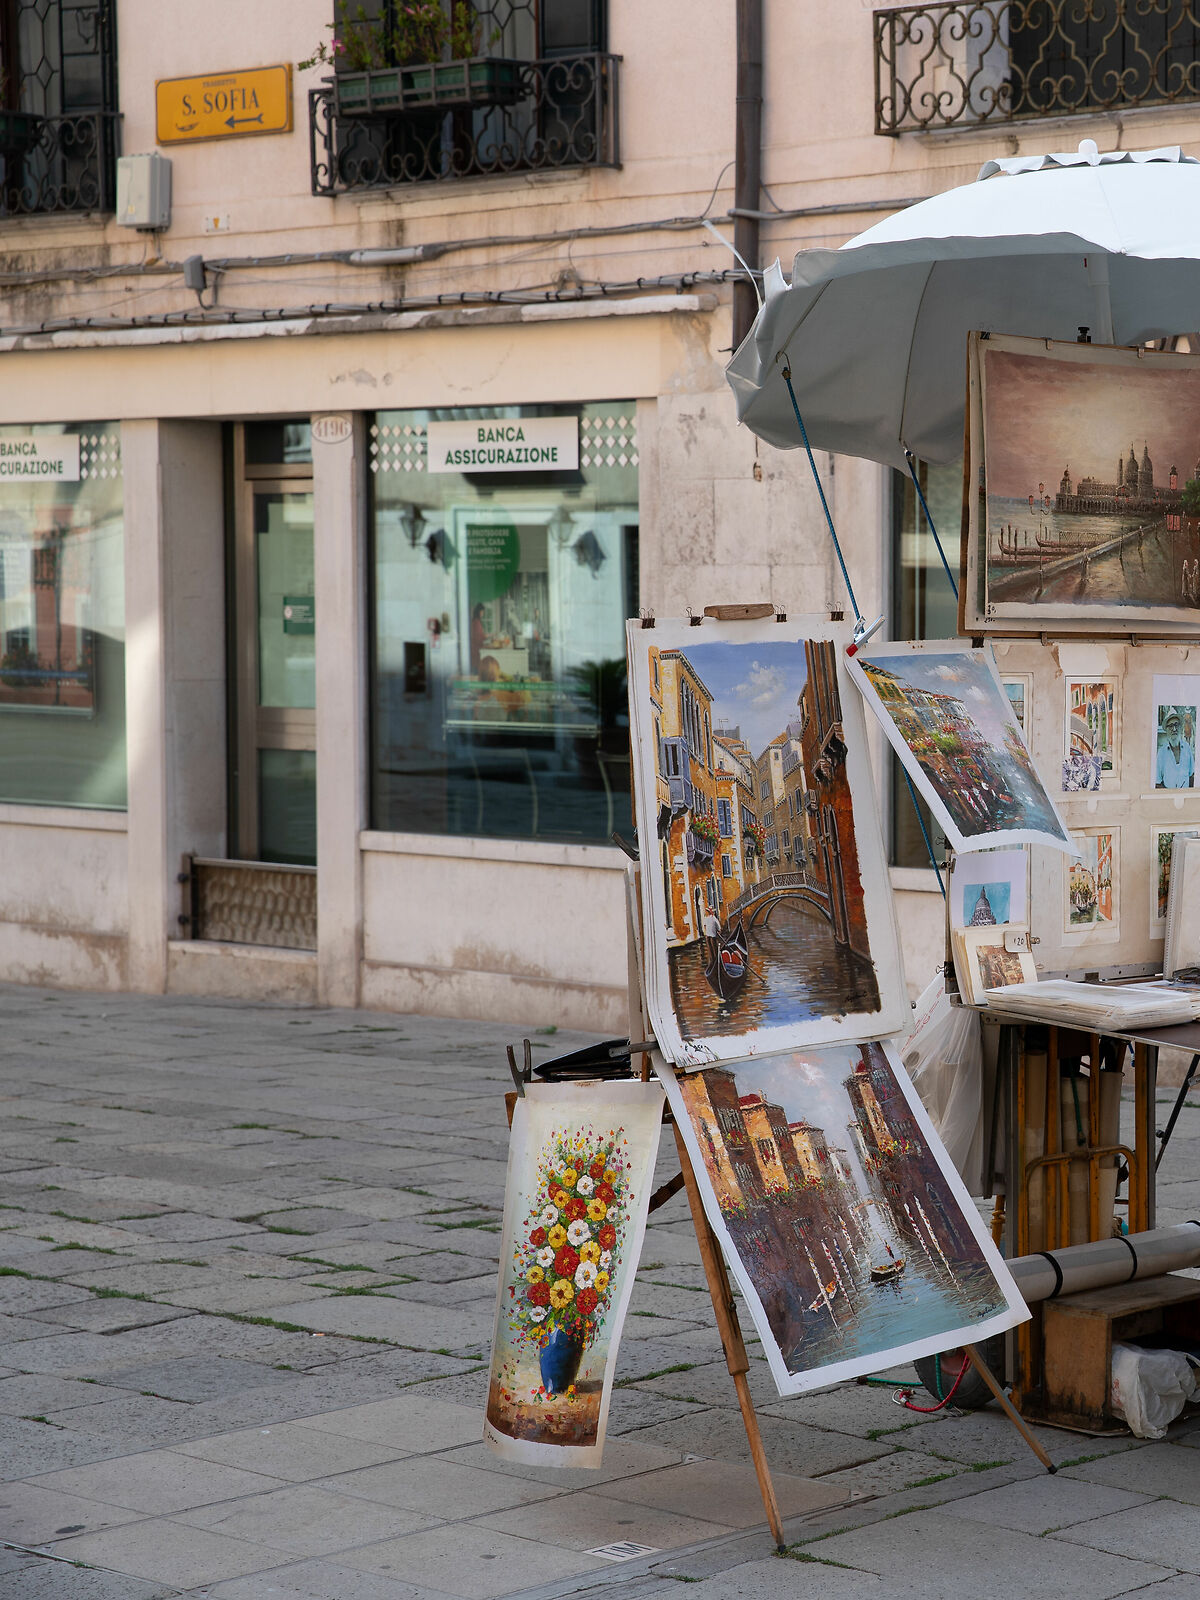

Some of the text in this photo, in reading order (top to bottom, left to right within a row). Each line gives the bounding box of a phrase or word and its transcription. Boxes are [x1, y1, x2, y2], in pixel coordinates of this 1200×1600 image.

[182, 87, 259, 116] S. SOFIA
[477, 427, 525, 443] BANCA
[0, 442, 38, 456] BANCA
[445, 447, 558, 465] ASSICURAZIONE
[591, 1542, 652, 1558] TIM
